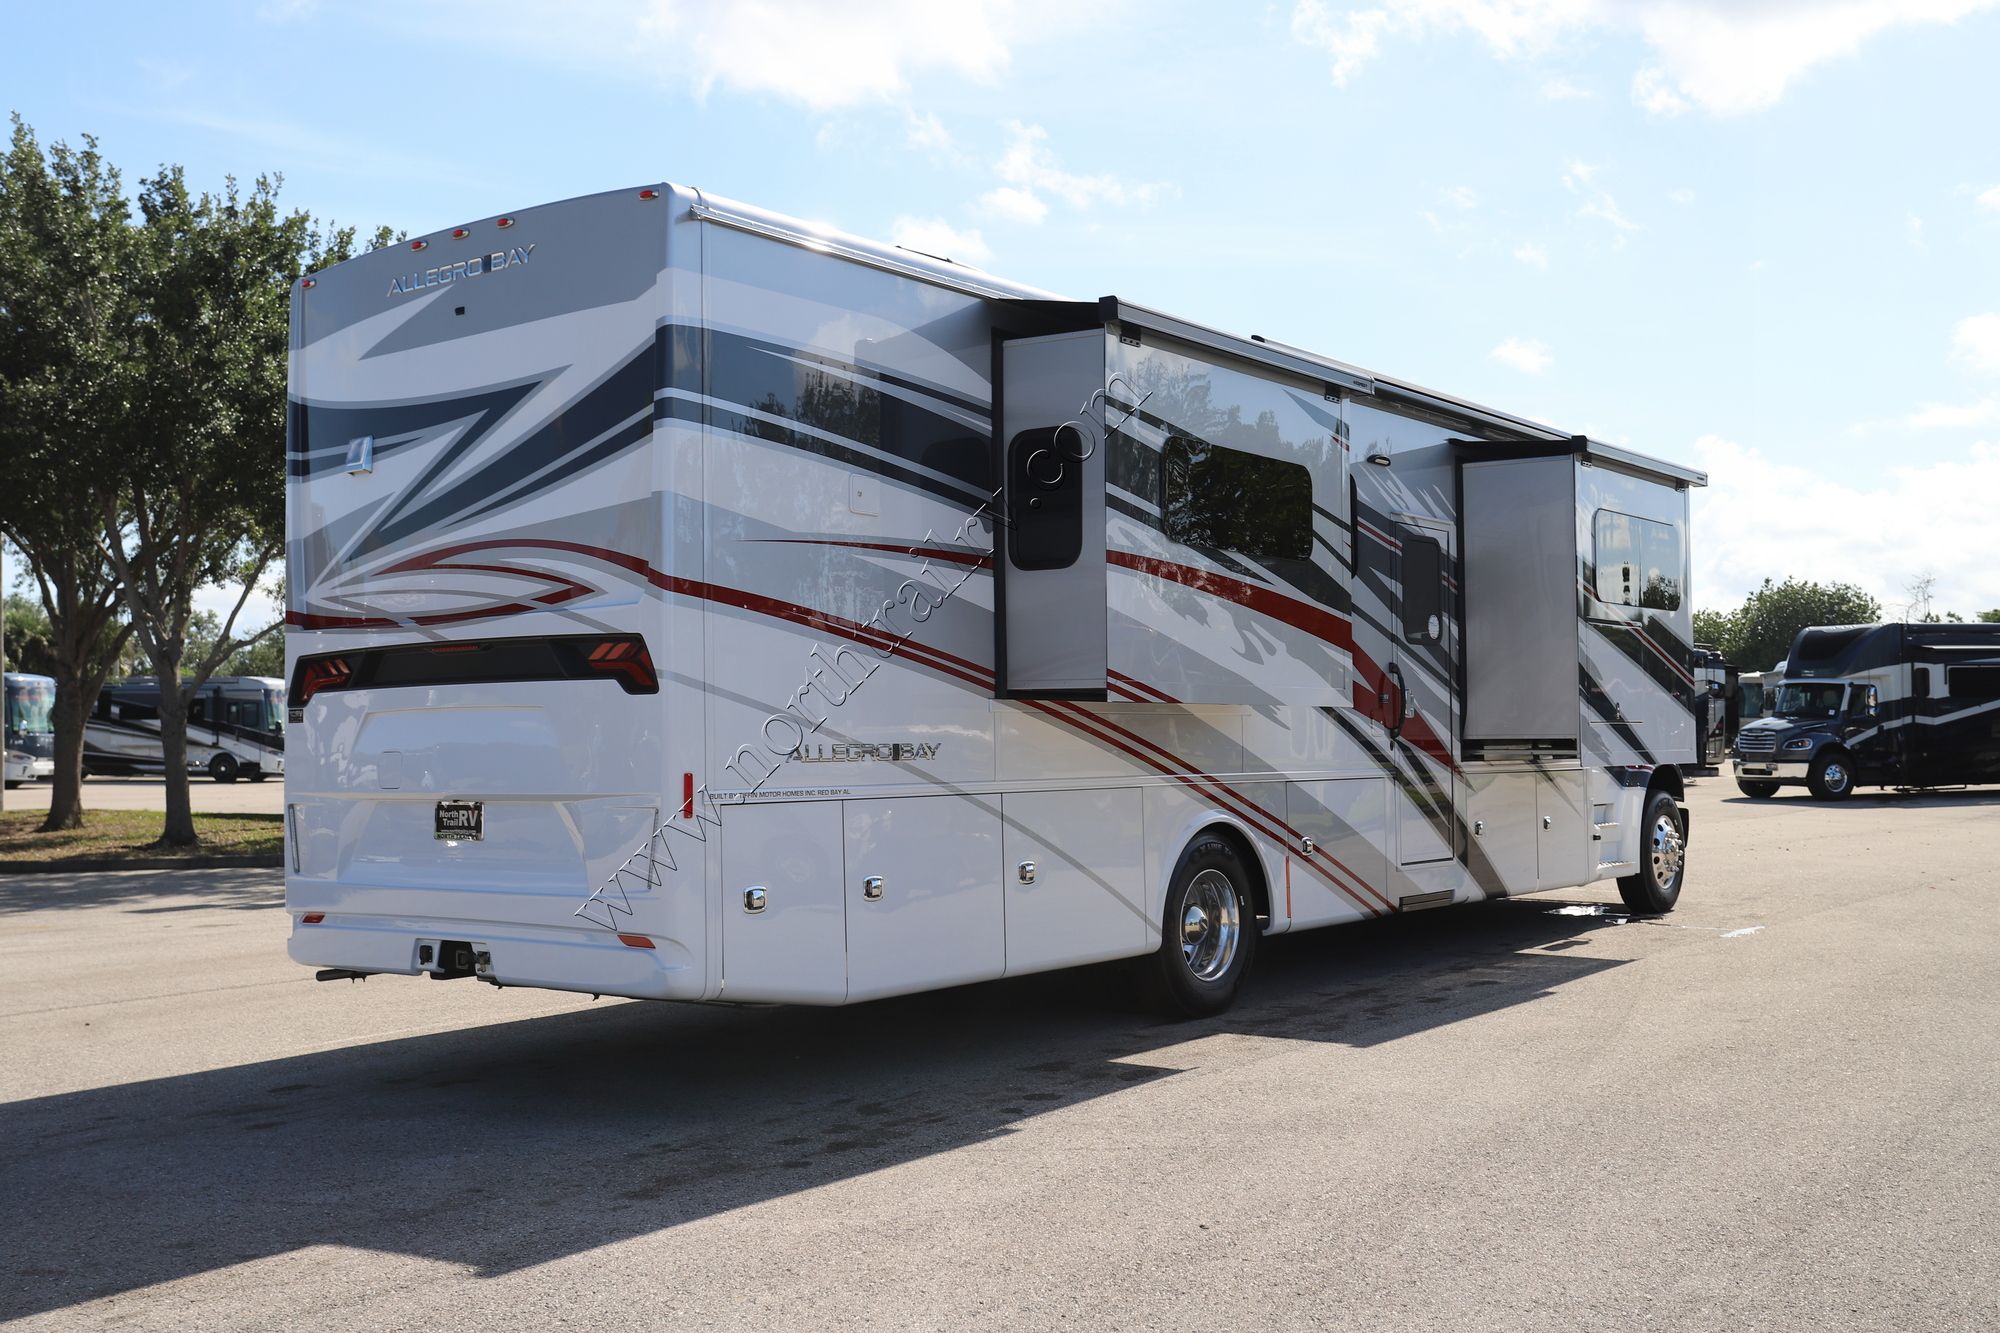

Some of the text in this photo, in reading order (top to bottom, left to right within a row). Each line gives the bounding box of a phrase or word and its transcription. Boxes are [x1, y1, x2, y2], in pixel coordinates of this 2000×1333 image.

[387, 243, 536, 297] ALLEGRO BAY
[785, 742, 942, 764] ALLEGRO BAY
[739, 791, 758, 799] TIFFIN
[440, 810, 459, 818] North
[459, 810, 479, 827] RV
[442, 818, 459, 826] Trail
